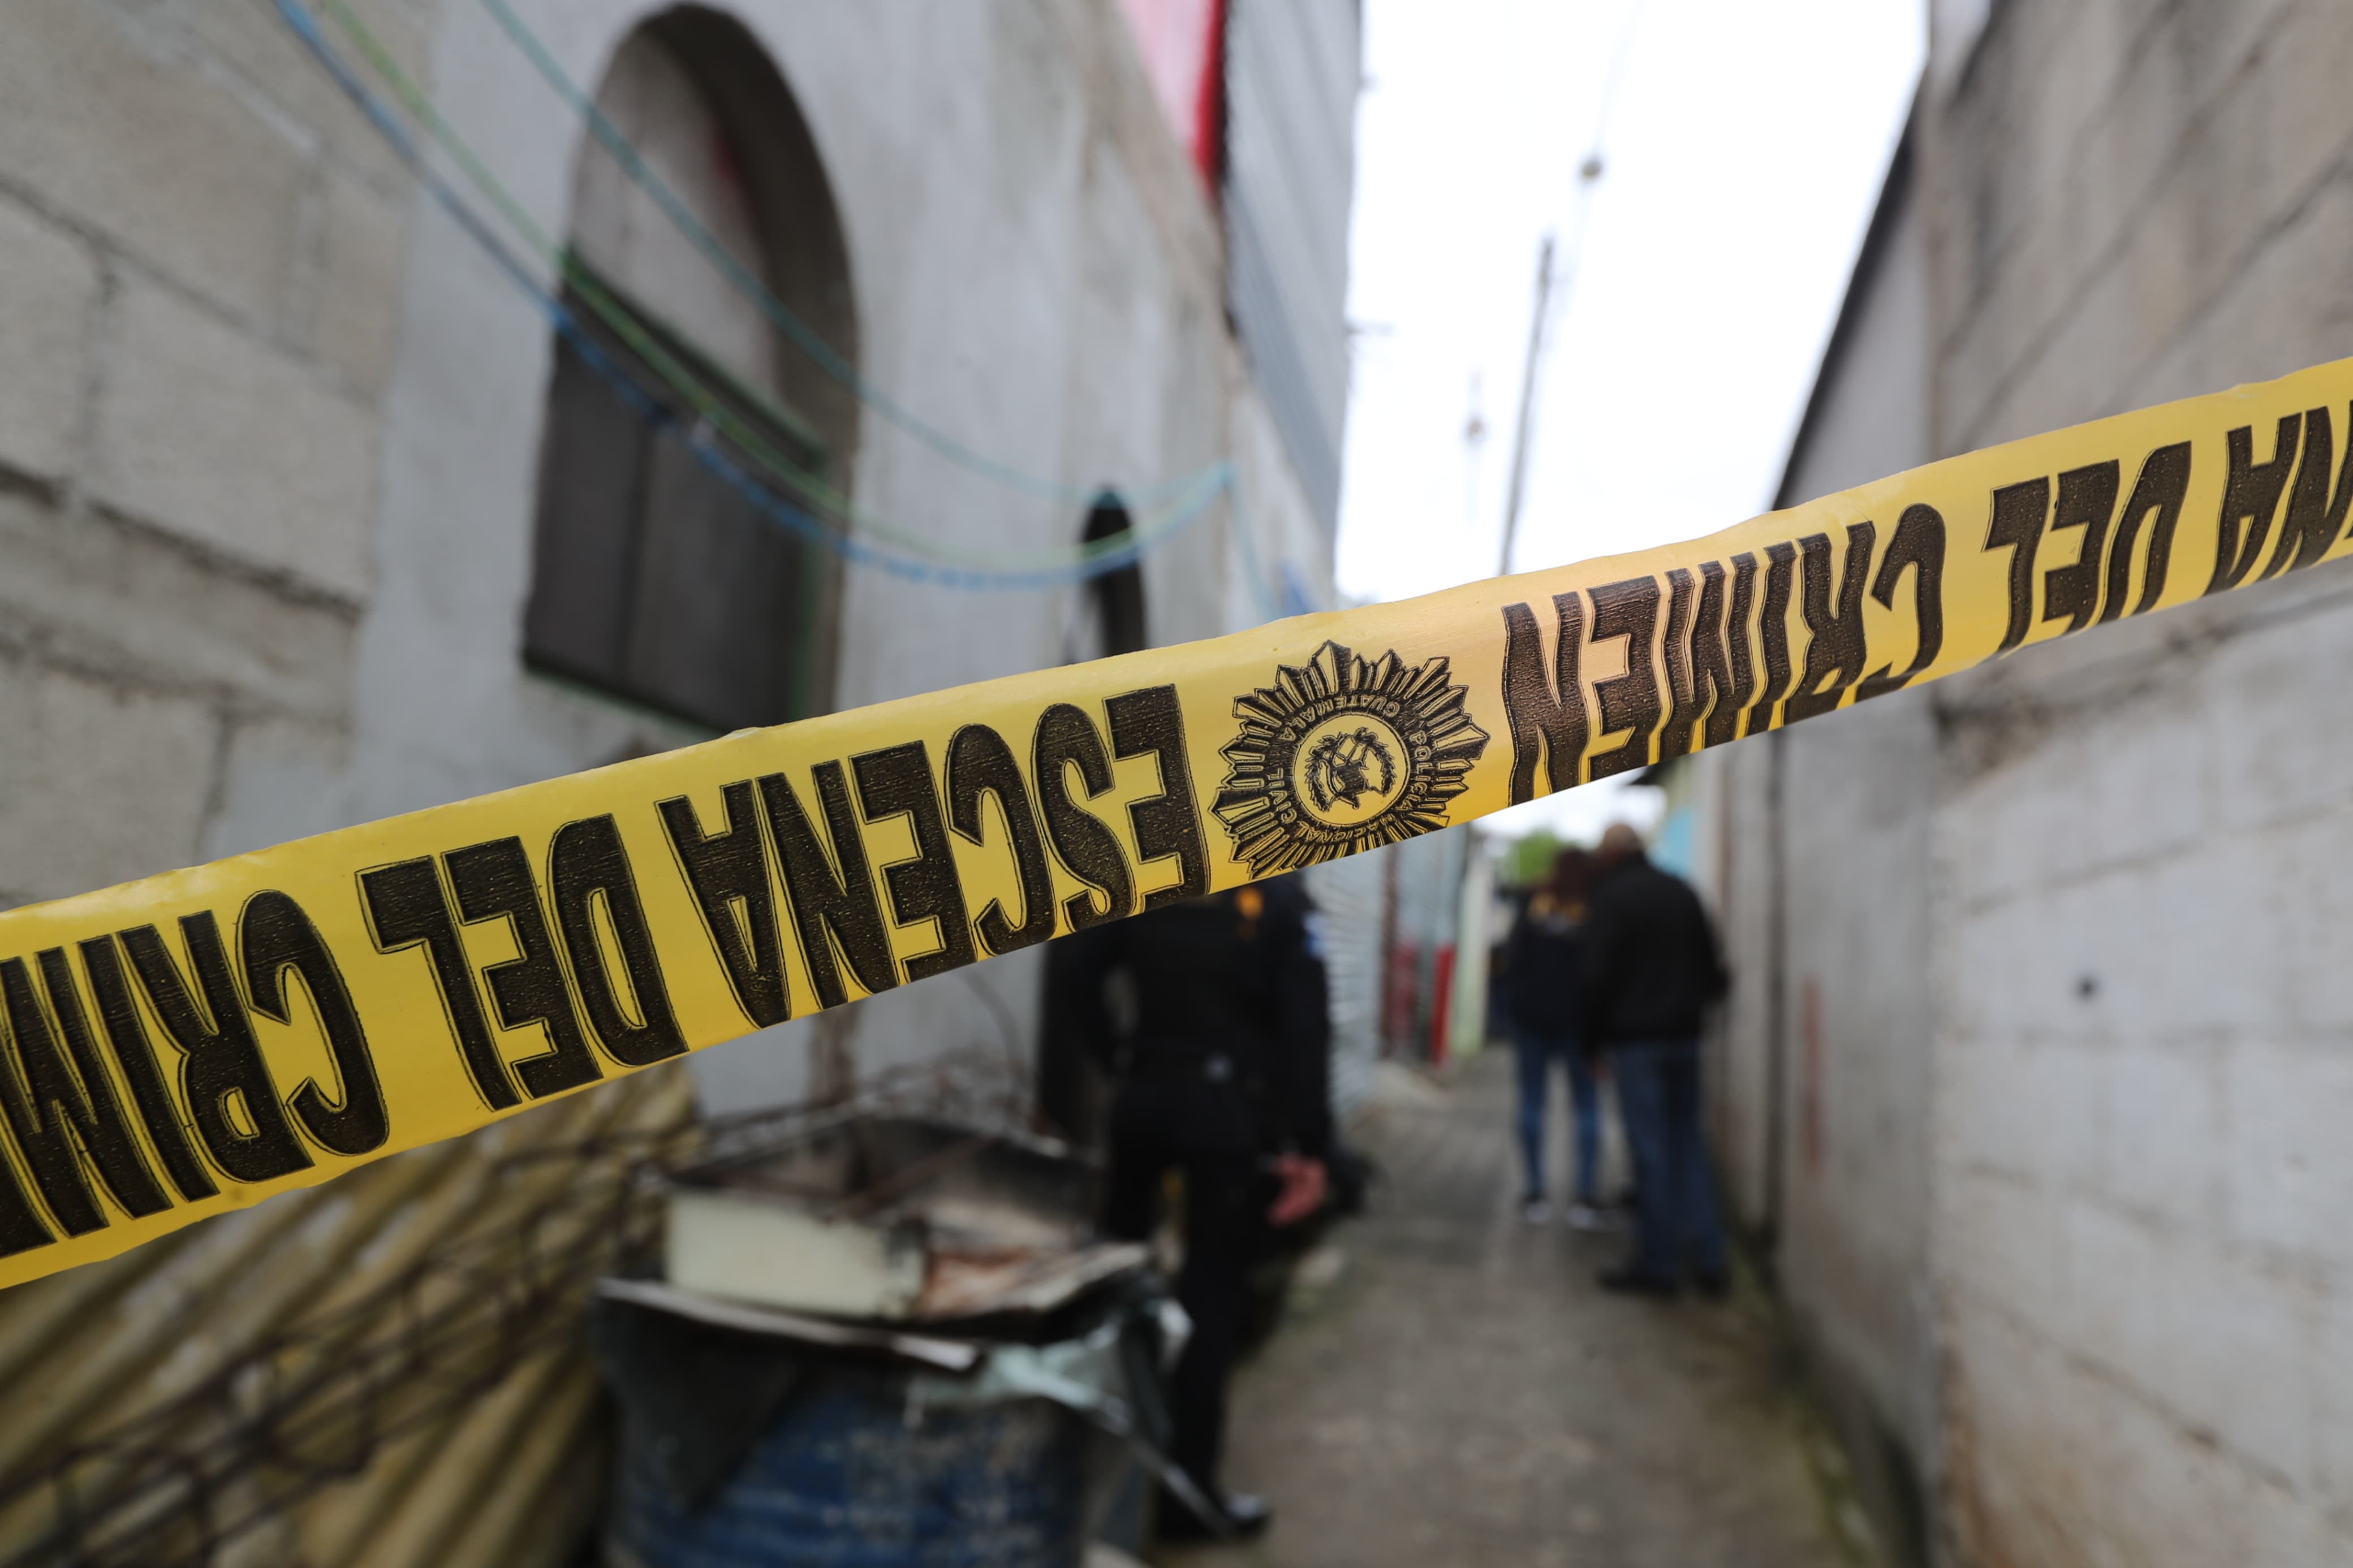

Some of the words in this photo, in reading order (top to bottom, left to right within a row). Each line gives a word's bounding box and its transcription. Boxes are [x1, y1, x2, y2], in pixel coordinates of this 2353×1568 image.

[1981, 440, 2192, 652] DEL
[2199, 400, 2353, 597] NA
[1280, 694, 1400, 741] GUATEMALA
[1502, 503, 1946, 807] CRIMEN
[654, 684, 1210, 1029] ESCENA
[1269, 768, 1297, 823] CIVIL
[1396, 731, 1432, 811] POLICIA
[355, 813, 689, 1112] DEL
[0, 889, 390, 1258] CRIM
